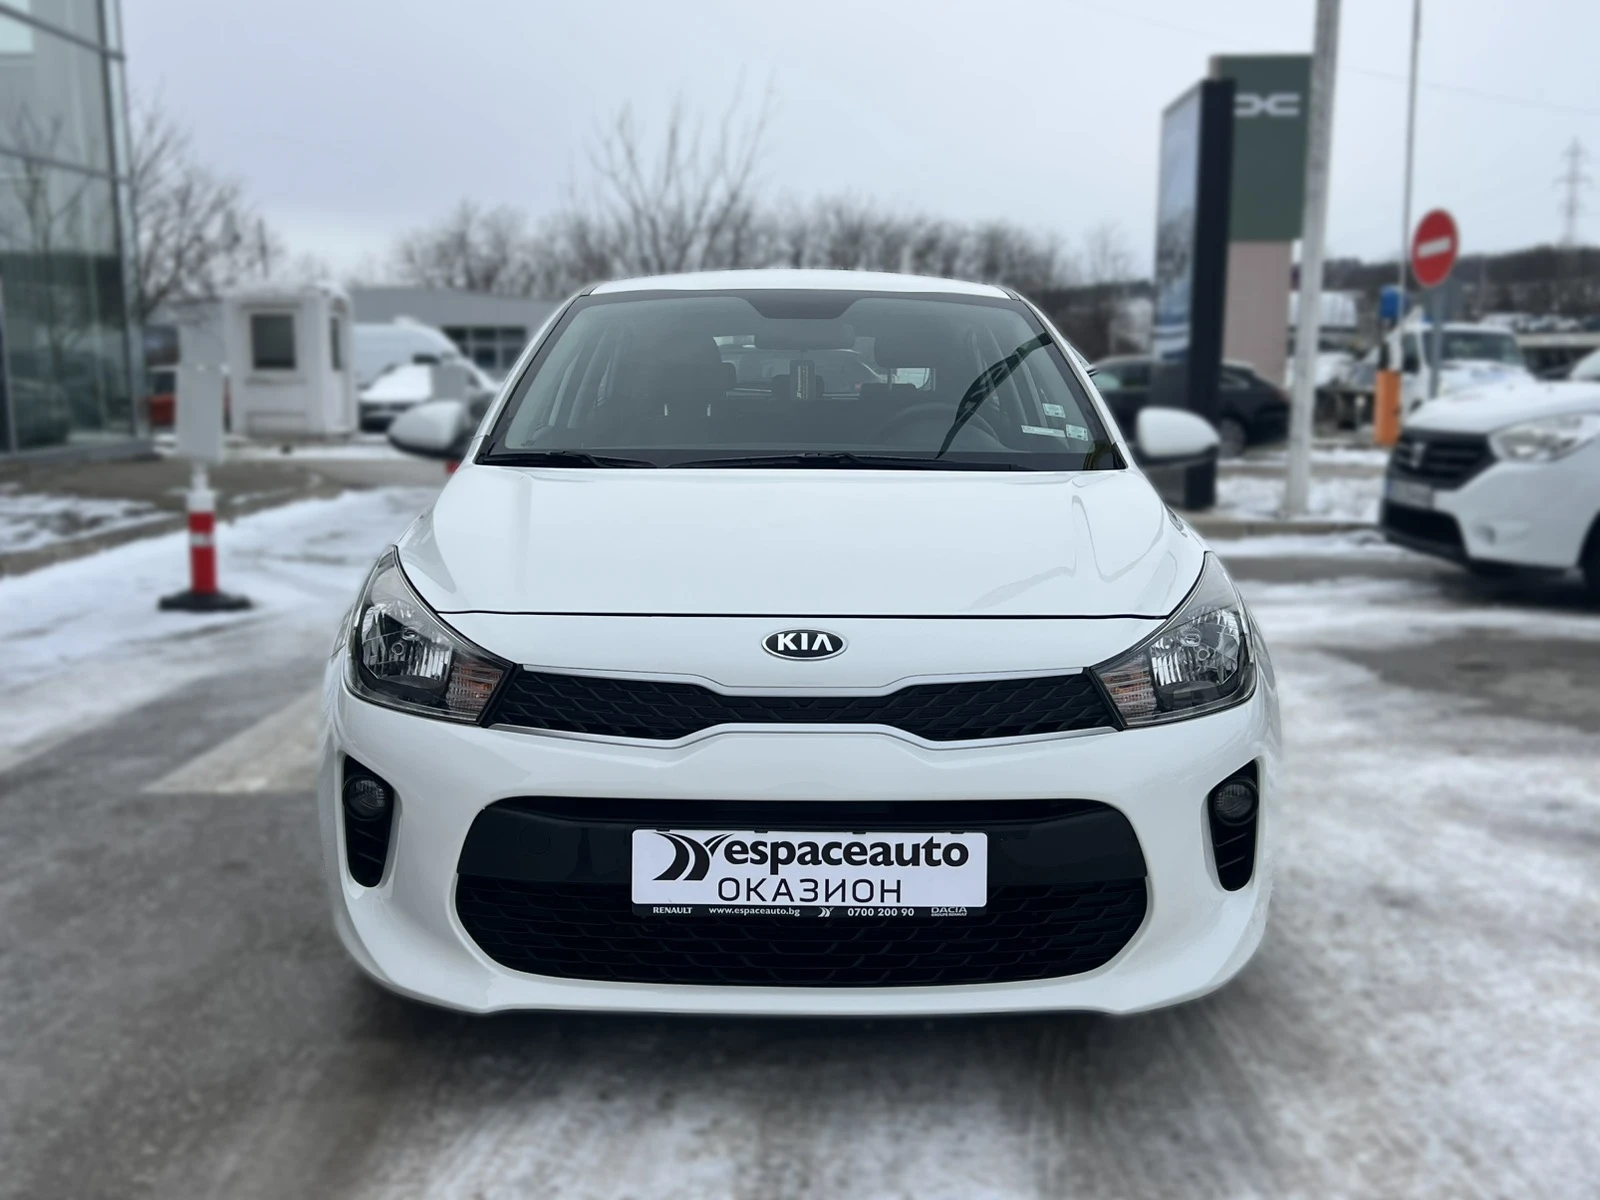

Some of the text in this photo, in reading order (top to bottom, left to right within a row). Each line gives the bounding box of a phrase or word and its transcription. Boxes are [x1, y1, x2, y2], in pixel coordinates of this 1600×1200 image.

[777, 632, 833, 652] KIA
[724, 836, 969, 875] espaceauto
[718, 877, 902, 903] ОКАЗИОН
[652, 906, 693, 914] RENAULT
[709, 907, 800, 916] www.espaceauto.bg
[847, 908, 915, 917] 0700 200 90
